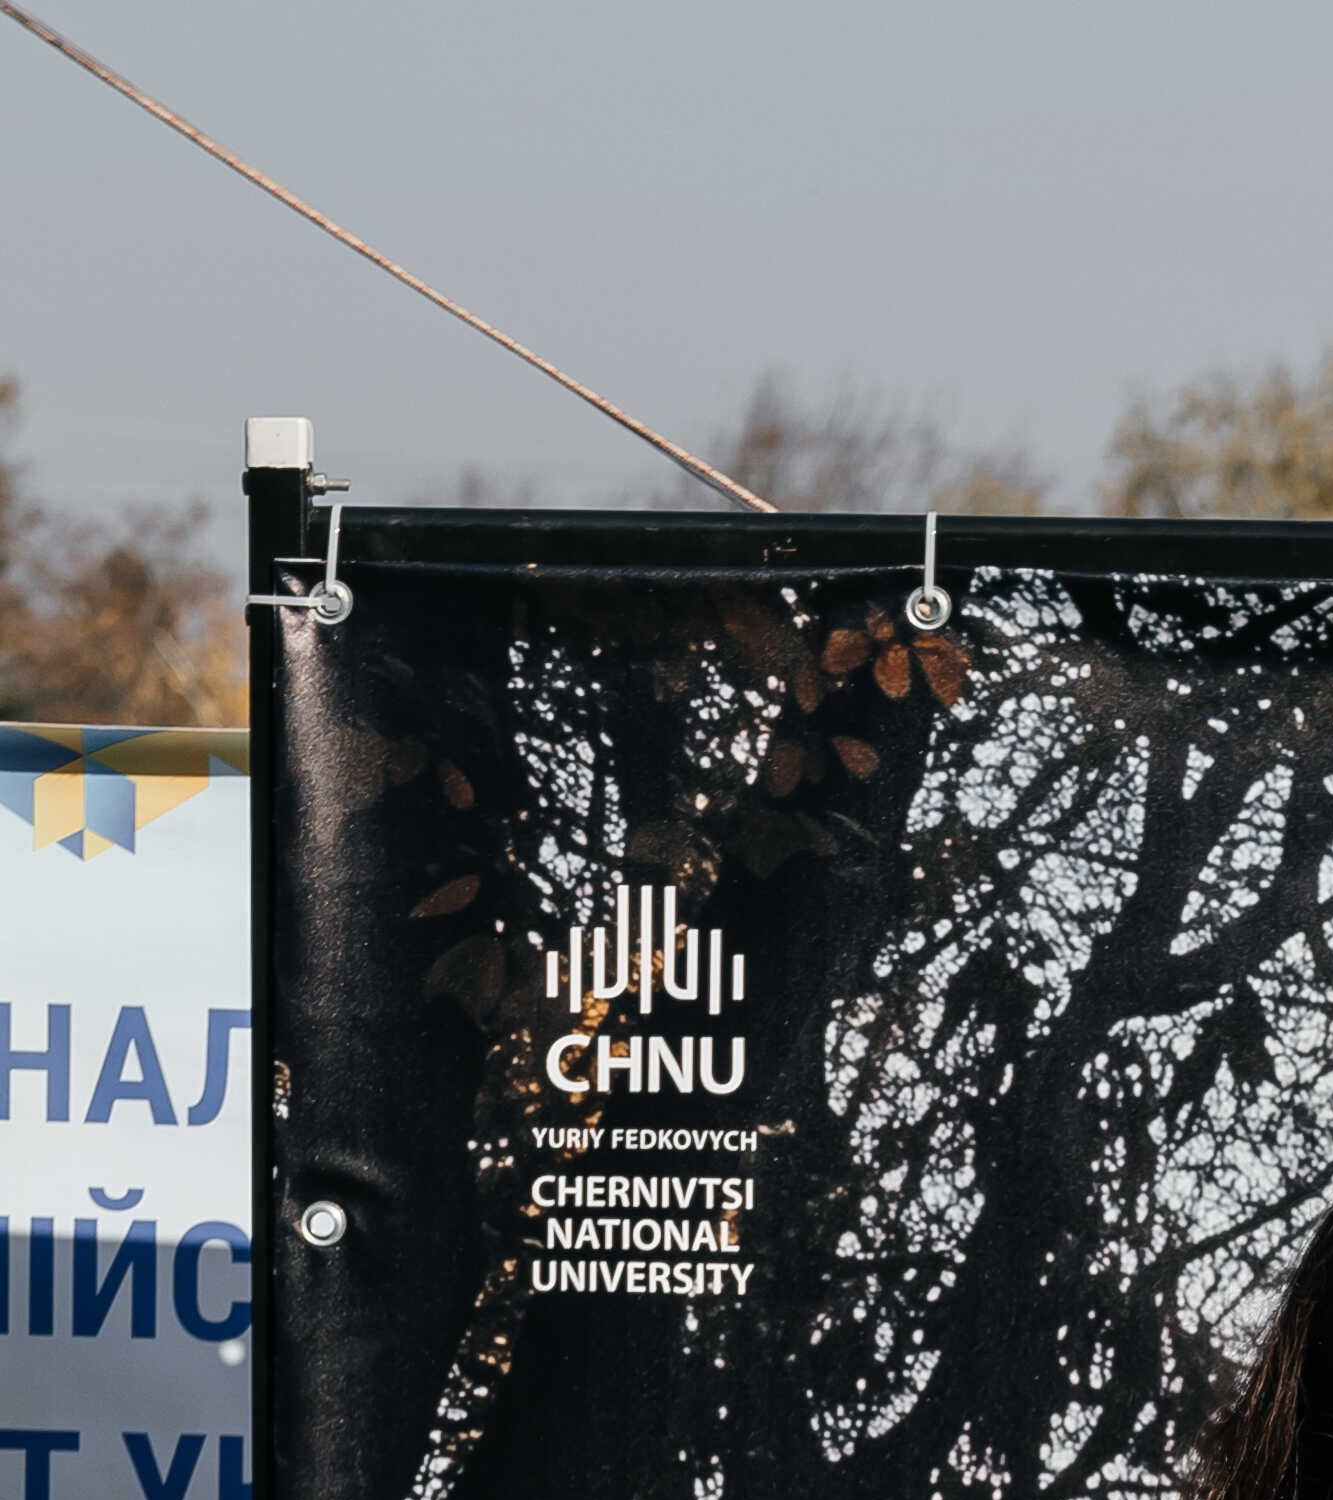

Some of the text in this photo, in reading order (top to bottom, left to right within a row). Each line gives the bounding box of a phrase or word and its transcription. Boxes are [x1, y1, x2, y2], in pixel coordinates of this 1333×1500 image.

[546, 1034, 746, 1094] CHNU
[532, 1127, 758, 1151] YURIY FEDKOVYCH
[531, 1175, 755, 1210] CHERNIVTSI
[546, 1218, 741, 1252] NATIONAL
[532, 1259, 755, 1296] UNIVERSITY
